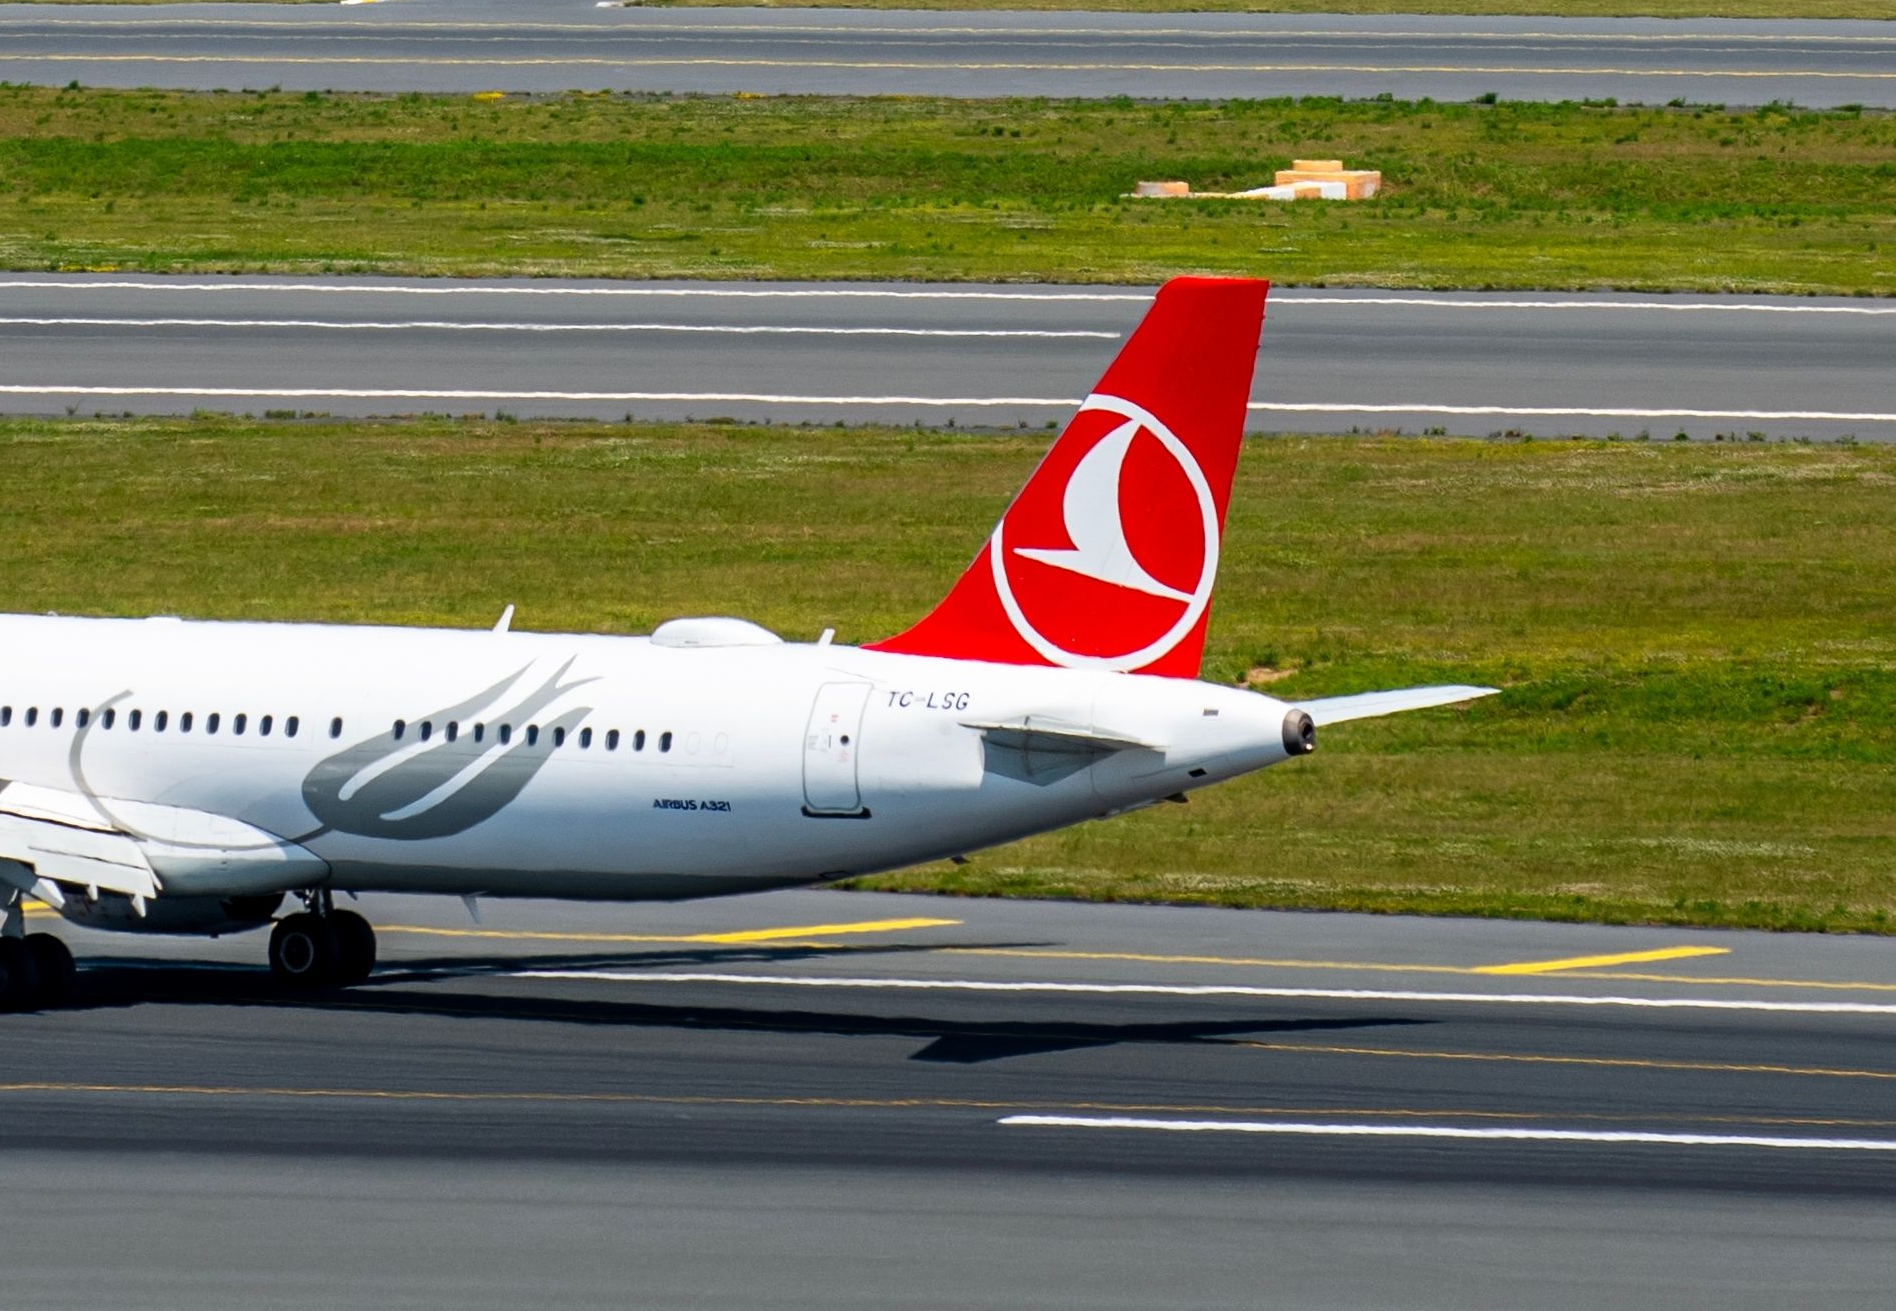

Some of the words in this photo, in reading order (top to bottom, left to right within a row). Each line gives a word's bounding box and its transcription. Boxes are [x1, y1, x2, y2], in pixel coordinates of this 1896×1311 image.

[887, 690, 970, 711] TC-LSG
[653, 799, 697, 810] AIRBUS
[700, 800, 731, 812] A321
